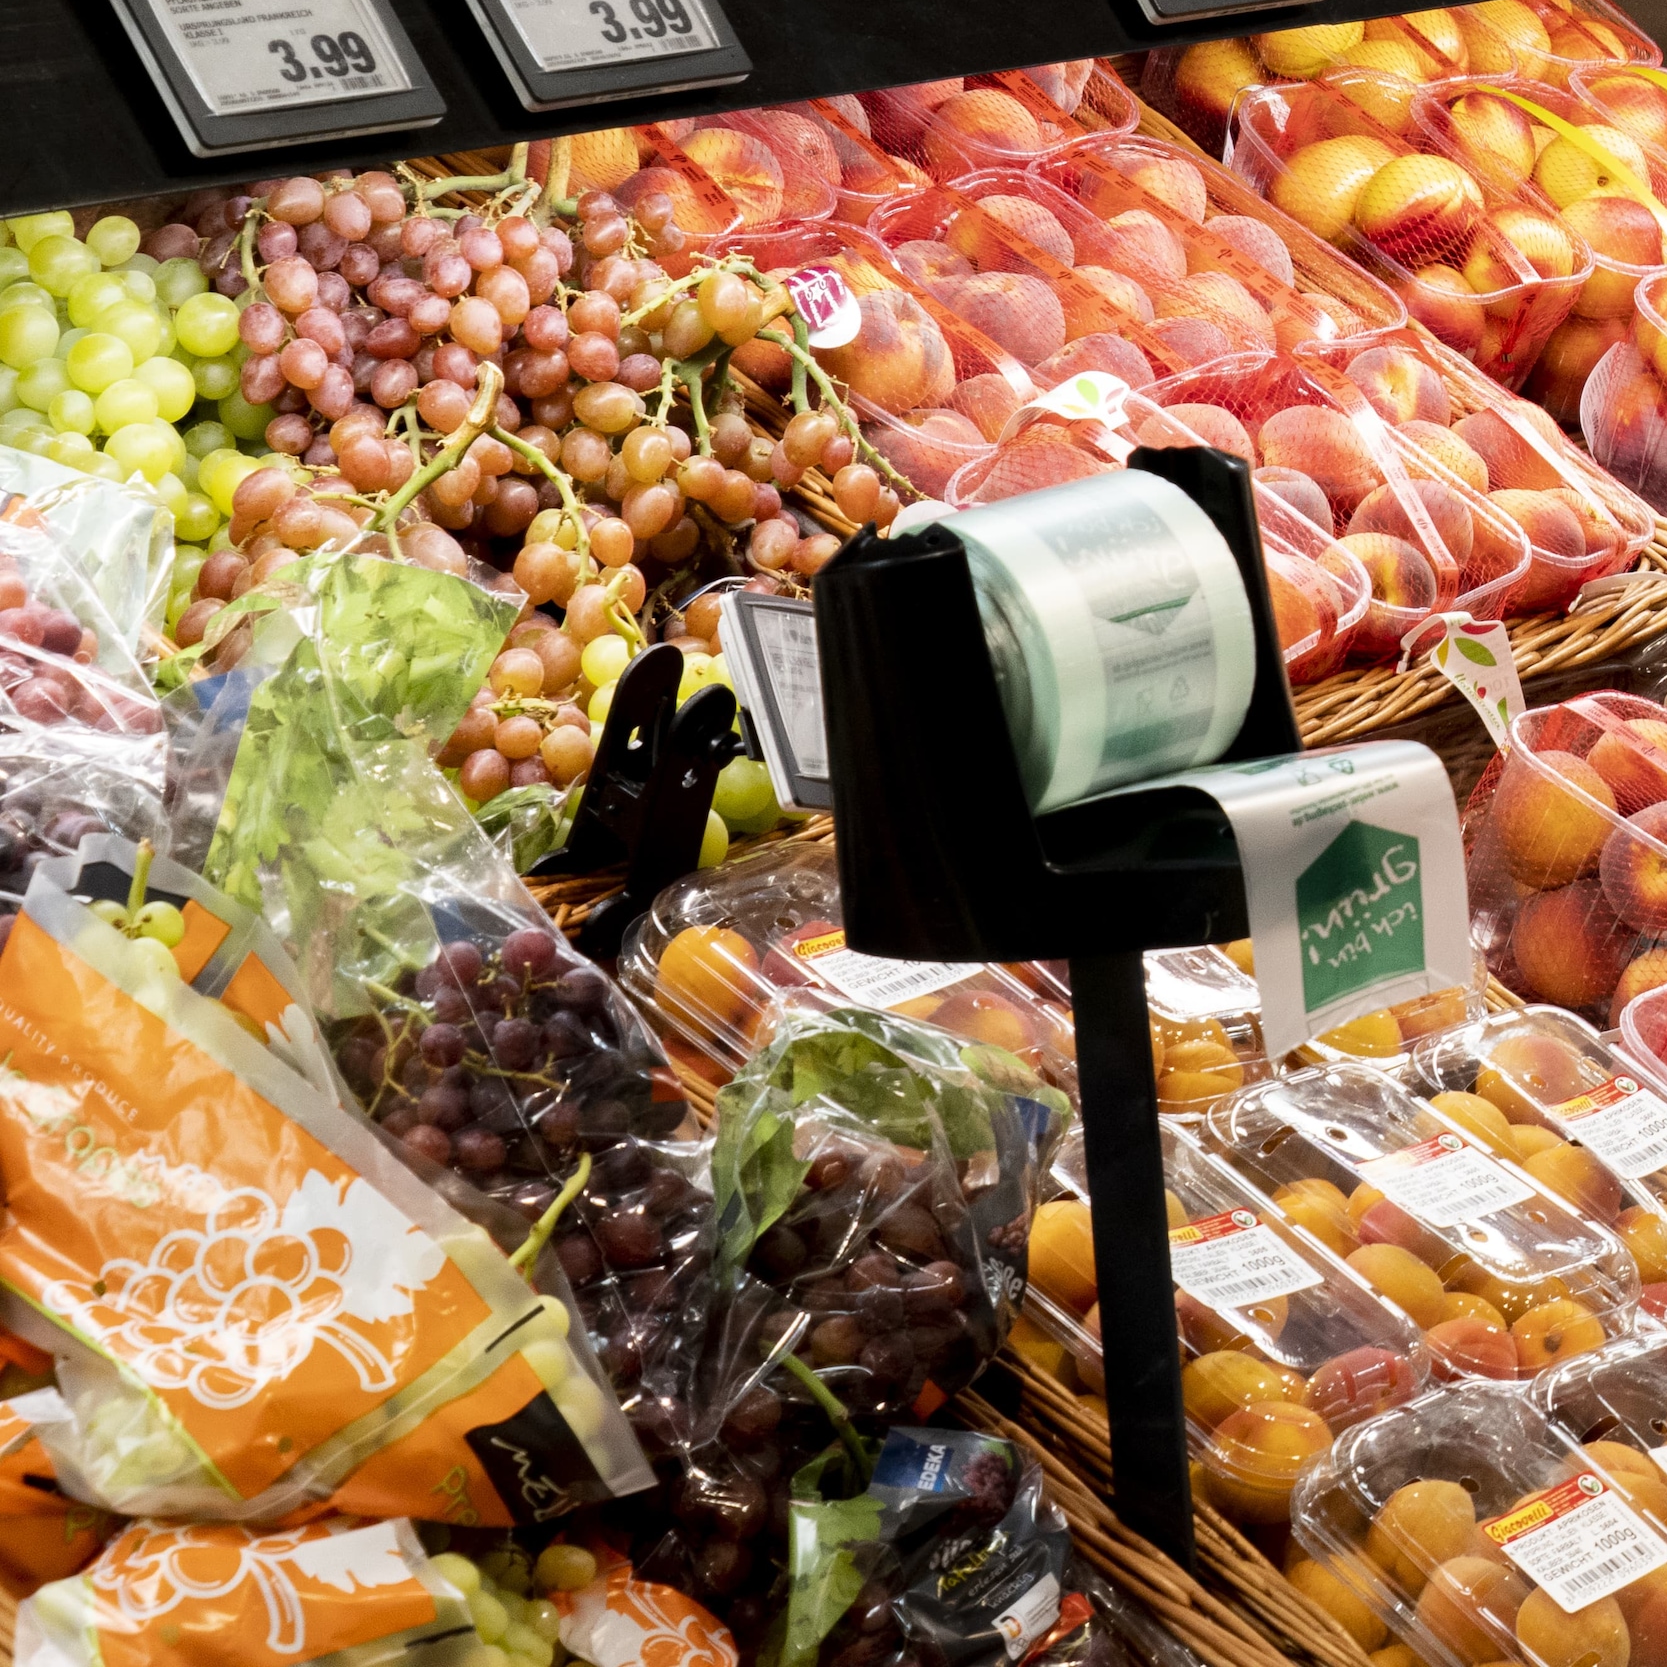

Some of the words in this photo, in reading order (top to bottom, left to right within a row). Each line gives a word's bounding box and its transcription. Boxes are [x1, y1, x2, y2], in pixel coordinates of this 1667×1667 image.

[169, 4, 199, 15] SORTE
[201, 0, 242, 12] ANGEBEN
[257, 8, 313, 23] FRANKREICH
[183, 29, 217, 40] KLASSE
[267, 30, 378, 83] 3.99
[1300, 843, 1418, 966] grün!
[1369, 900, 1419, 937] ich
[797, 934, 845, 957] Giacove
[1327, 930, 1373, 969] bin
[1460, 1172, 1499, 1191] 1000g
[1241, 1256, 1286, 1273] 1000g
[1489, 1504, 1550, 1540] Giacovelli
[1556, 1500, 1607, 1531] APRIKOSEN
[1593, 1525, 1638, 1553] 1000g
